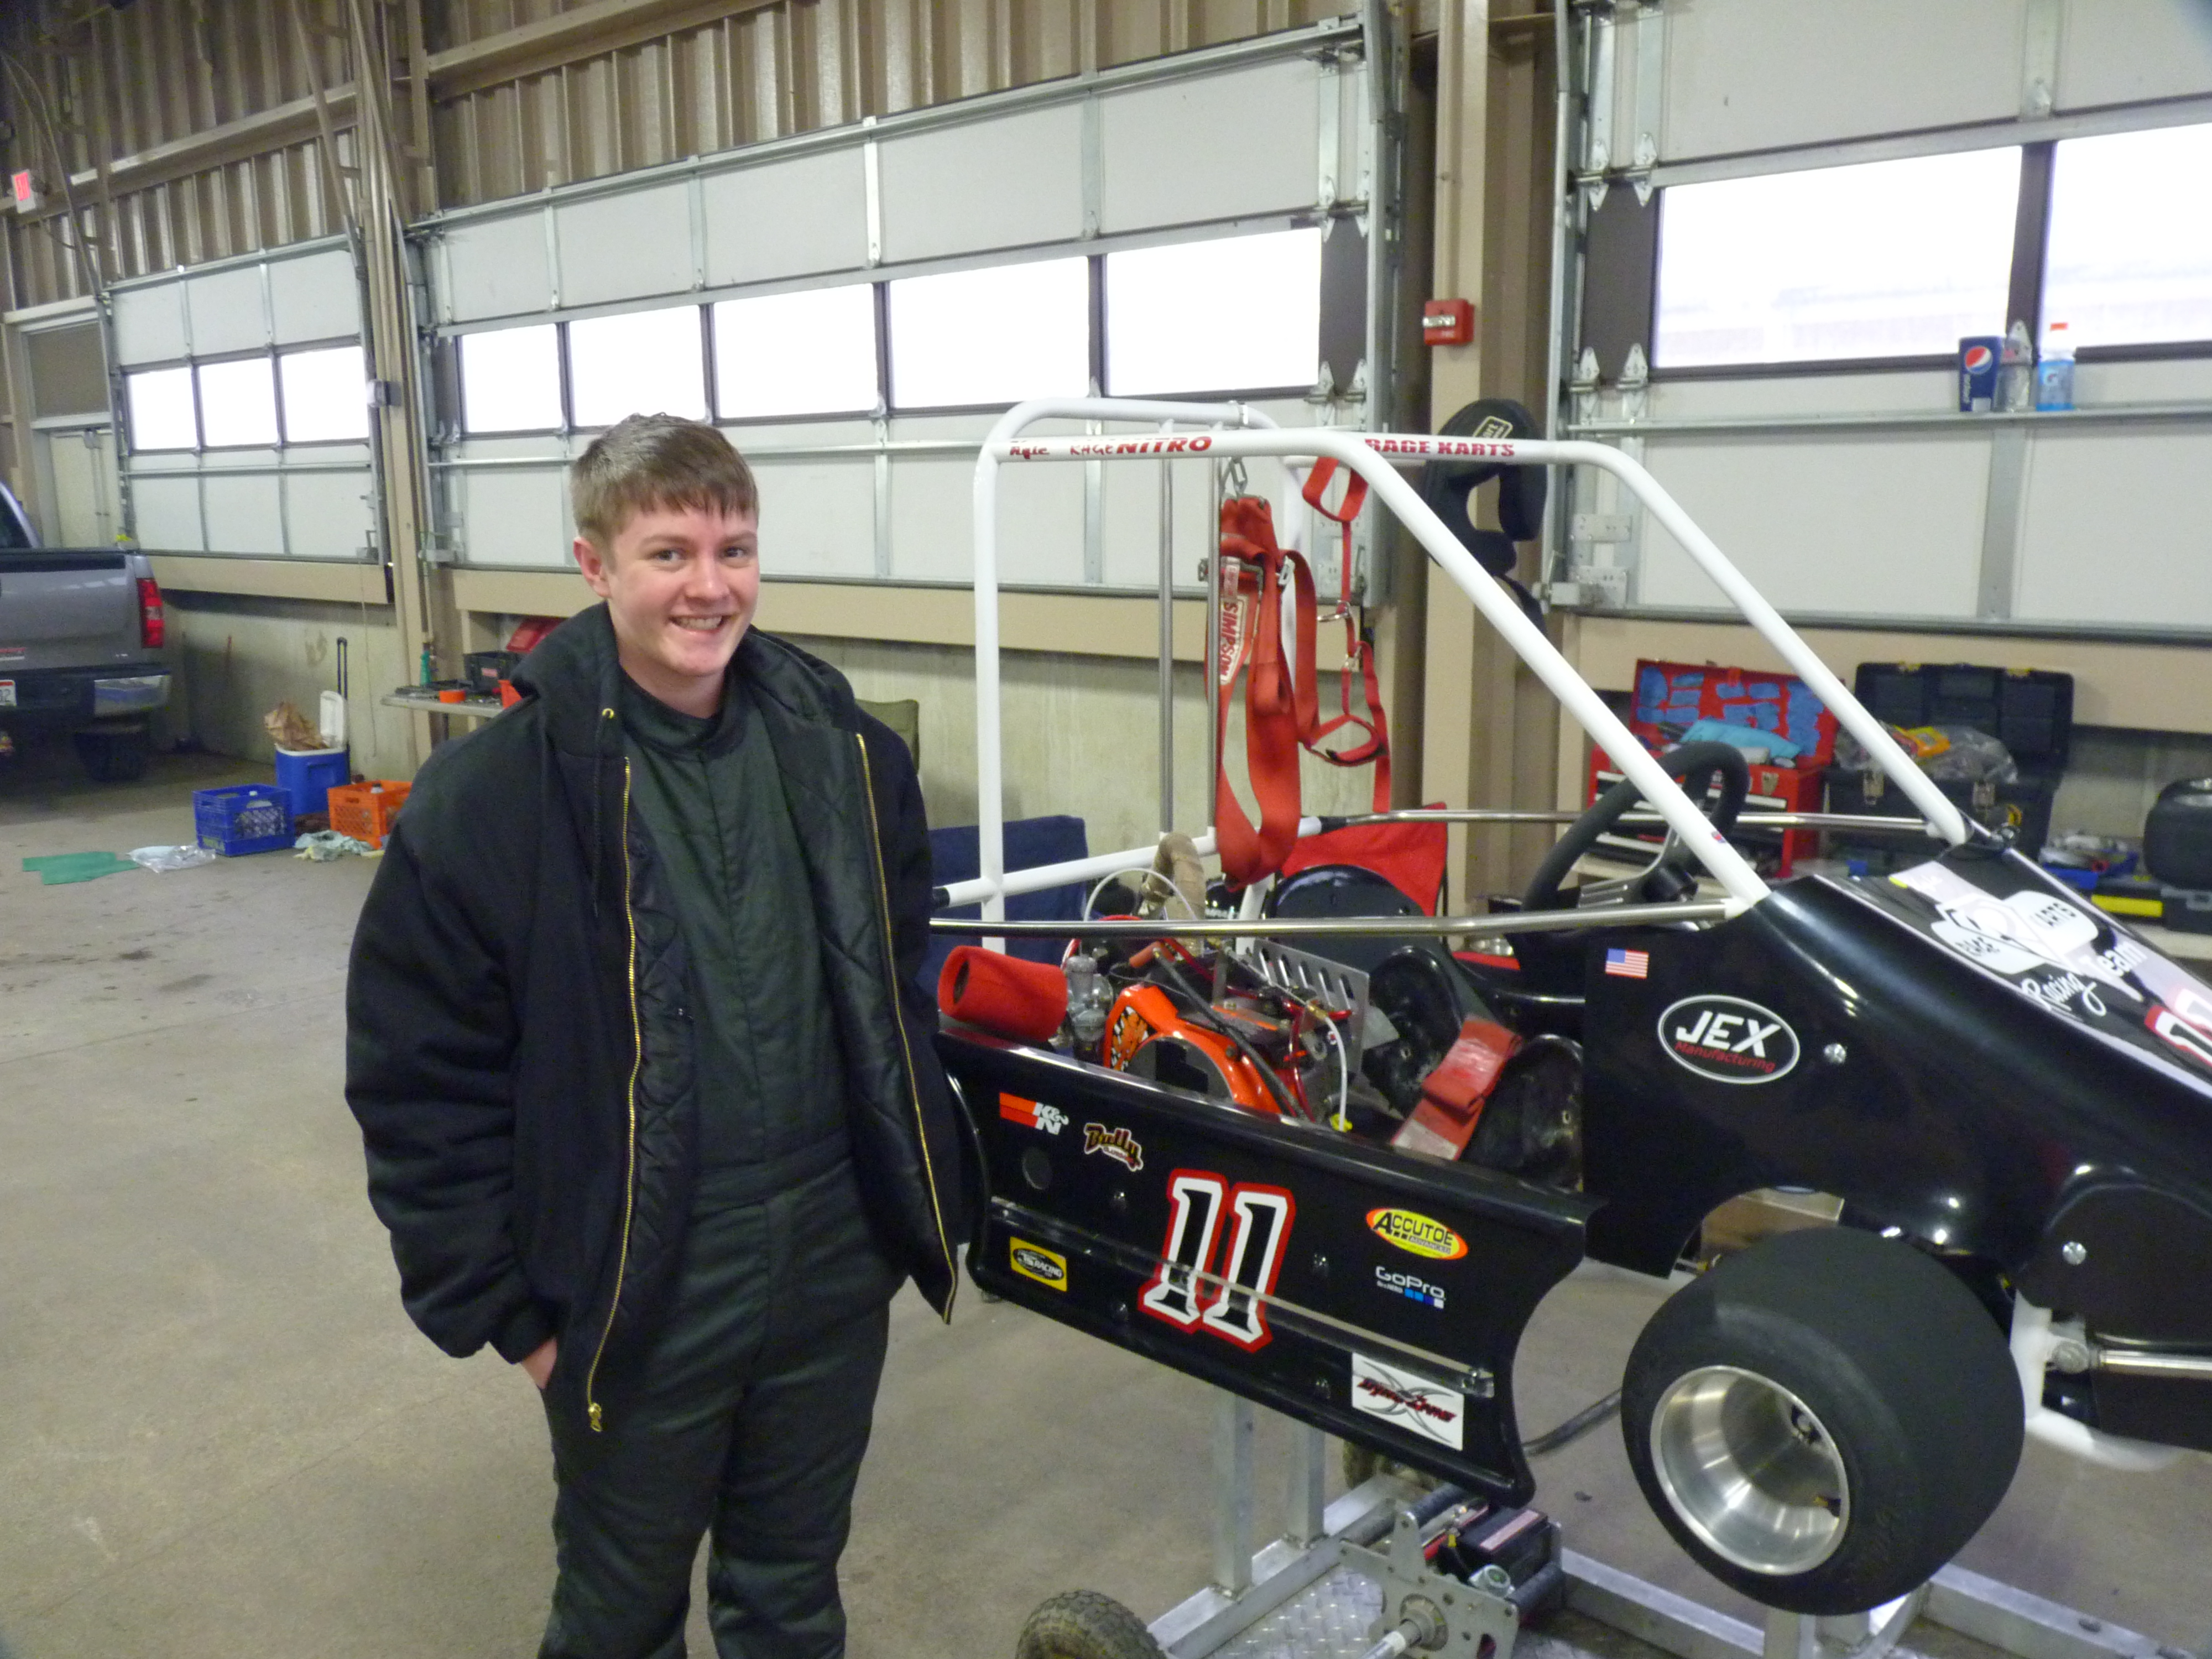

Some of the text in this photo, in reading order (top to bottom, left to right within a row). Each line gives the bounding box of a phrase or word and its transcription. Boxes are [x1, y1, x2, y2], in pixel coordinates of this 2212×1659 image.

[1116, 436, 1212, 454] NITRO
[1365, 439, 1515, 456] RAGE KARTS
[1219, 601, 1239, 677] SIMPSON
[2078, 941, 2148, 987] Team
[2021, 971, 2107, 1017] Racing
[1675, 1010, 1782, 1058] JEX
[1674, 1041, 1777, 1074] Manufacturing
[1032, 1102, 1069, 1135] K&N
[1083, 1123, 1144, 1172] Bully
[1373, 1212, 1453, 1246] ACCUTOE
[1137, 1167, 1297, 1354] 11
[1375, 1266, 1446, 1300] GoPro
